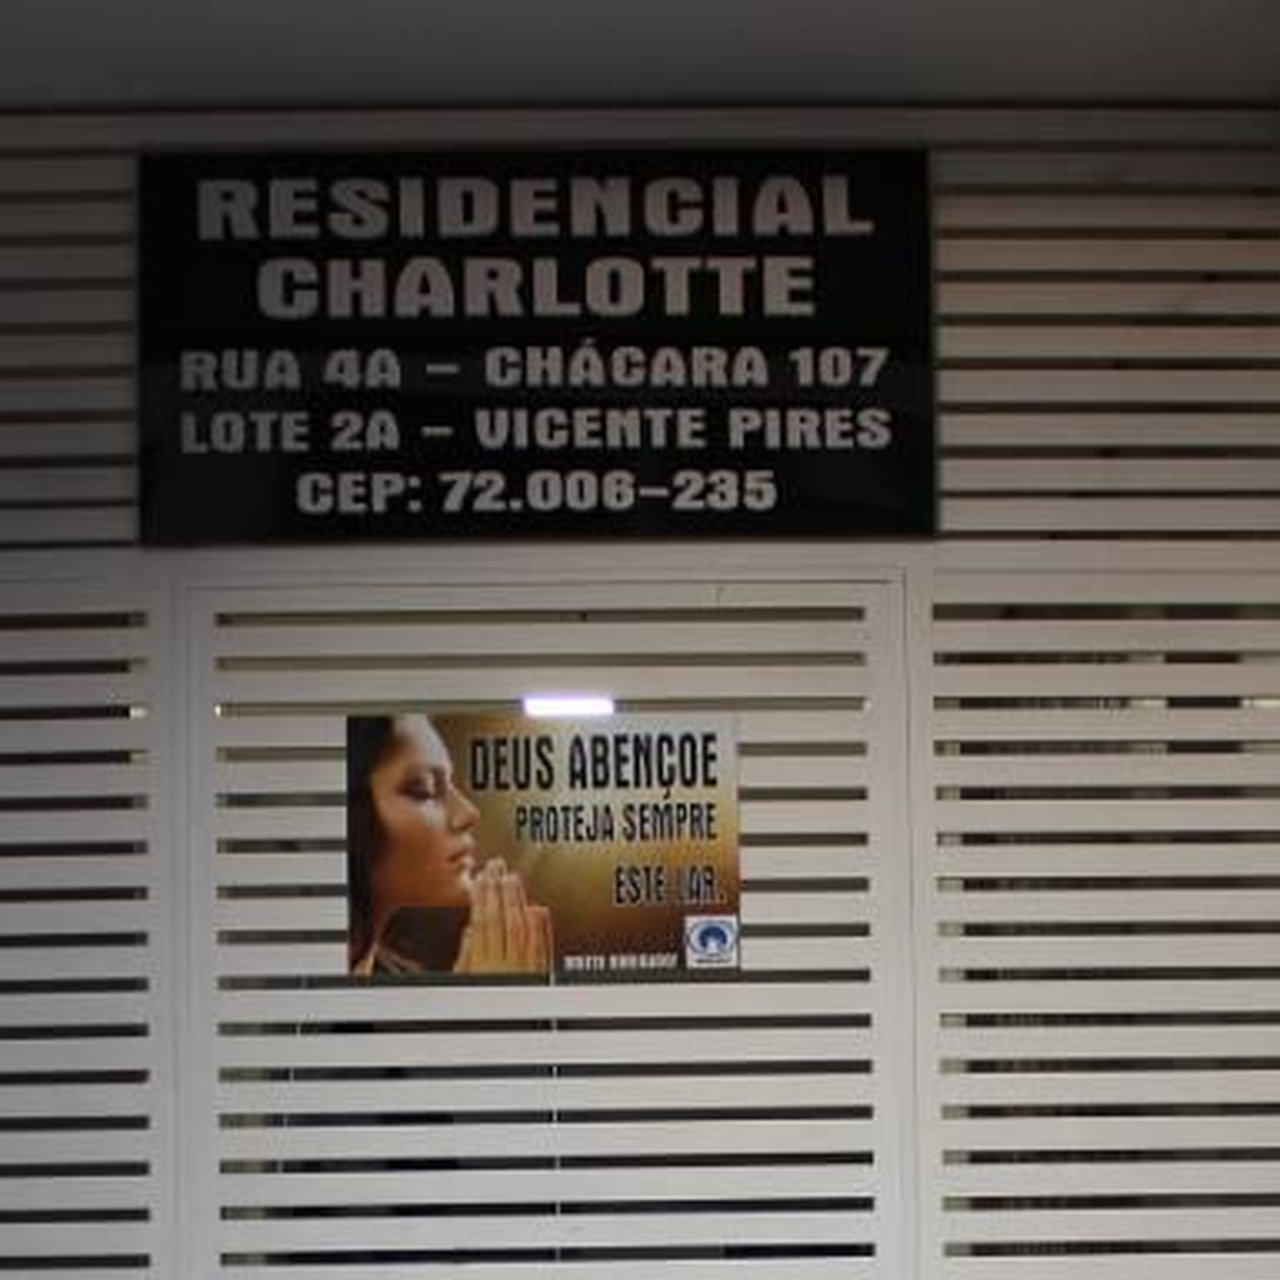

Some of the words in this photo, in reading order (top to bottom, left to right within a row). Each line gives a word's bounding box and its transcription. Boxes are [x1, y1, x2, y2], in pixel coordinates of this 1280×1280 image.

[197, 176, 873, 240] RESIDENCIAL
[256, 255, 815, 319] CHARLOTTE
[180, 349, 301, 391] RUA
[321, 349, 402, 389] 4A
[485, 338, 769, 388] CHÁCARA
[790, 347, 889, 387] 107
[180, 411, 309, 454] LOTE
[331, 411, 400, 451] 2A
[475, 408, 706, 450] VICENTE
[728, 408, 892, 449] PIRES
[296, 471, 423, 514] CEP:
[440, 469, 778, 512] 72.006-235
[471, 736, 555, 792] DEUS
[568, 732, 719, 800] ABENÇOE
[515, 805, 615, 844] PROTEJA
[622, 803, 718, 841] SEMPRE
[615, 866, 665, 904] ESTE
